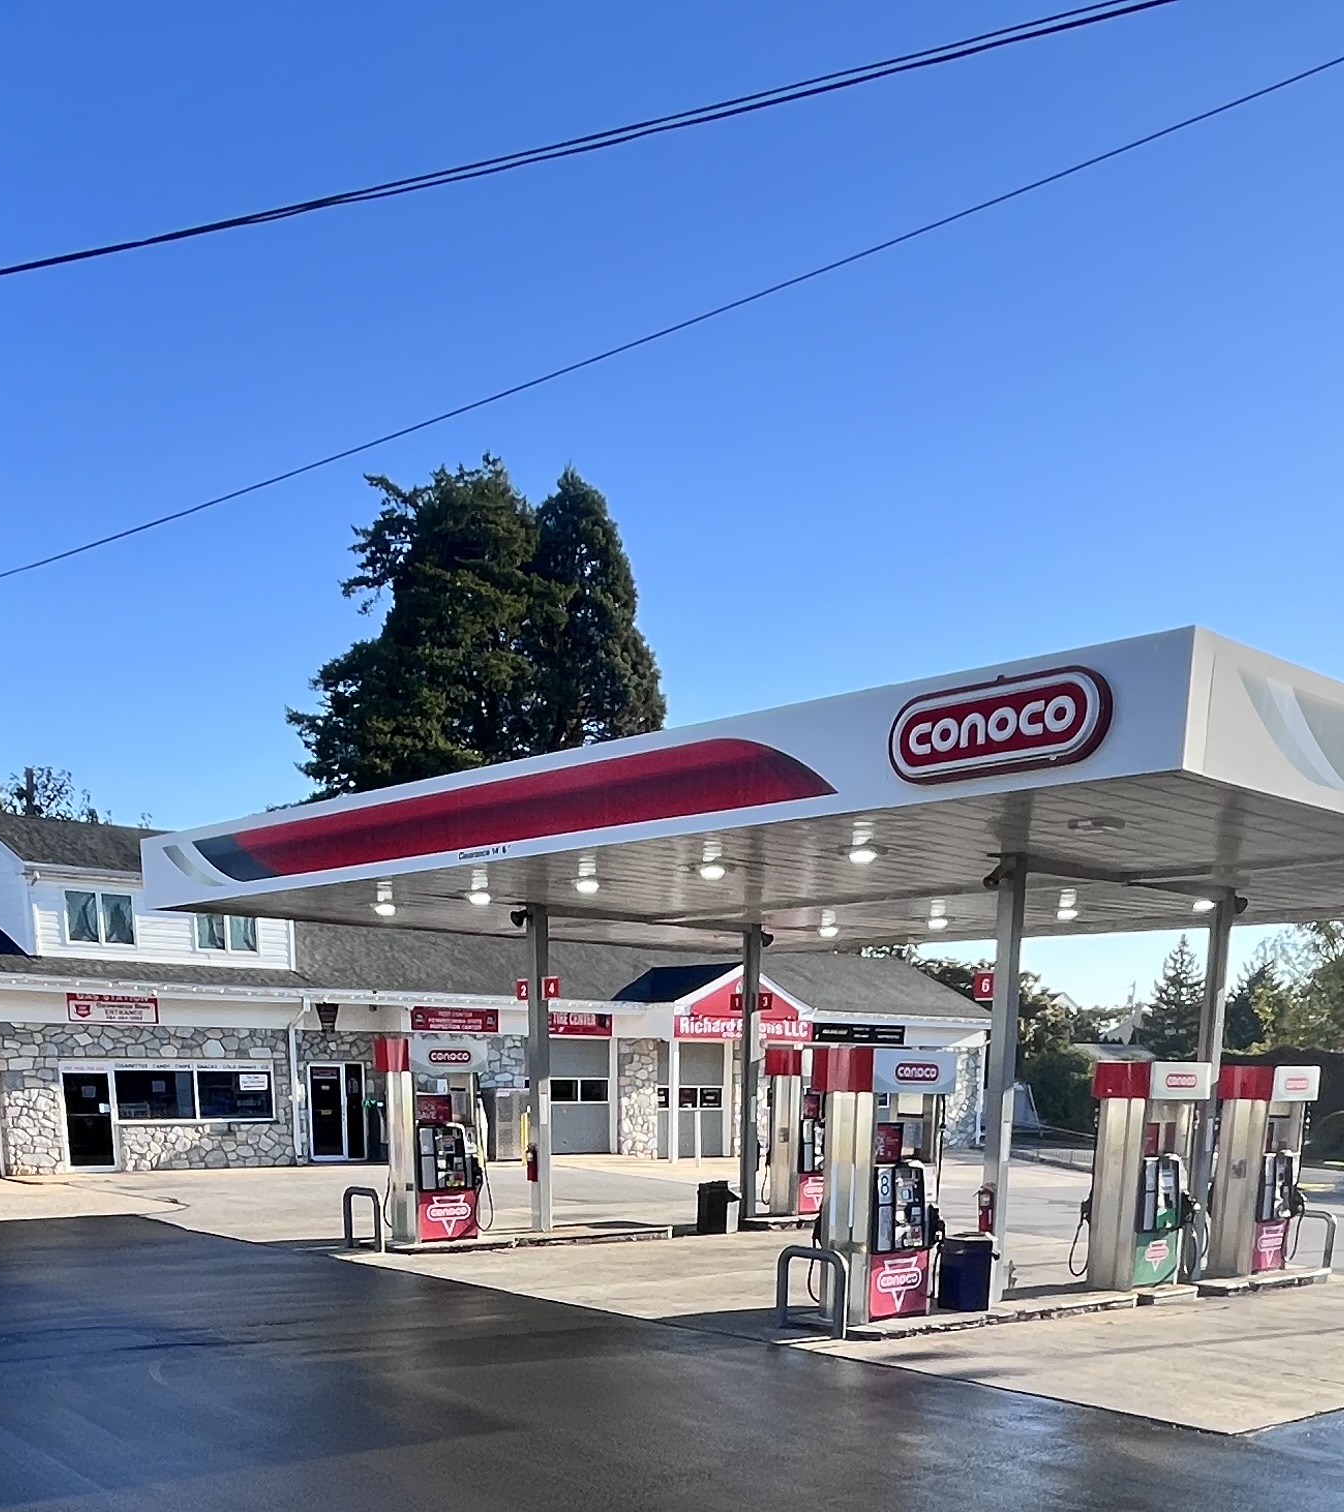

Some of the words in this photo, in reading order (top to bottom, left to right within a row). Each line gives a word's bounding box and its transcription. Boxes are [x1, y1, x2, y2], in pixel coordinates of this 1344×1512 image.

[520, 984, 527, 997] 2
[548, 982, 555, 994] 4
[981, 978, 991, 993] 6
[734, 997, 739, 1007] 1
[762, 996, 768, 1007] 3
[553, 1012, 568, 1025] TIRE
[569, 1013, 596, 1026] CENTER
[759, 1022, 783, 1036] ons
[783, 1020, 808, 1038] LLC
[880, 1175, 889, 1196] 8
